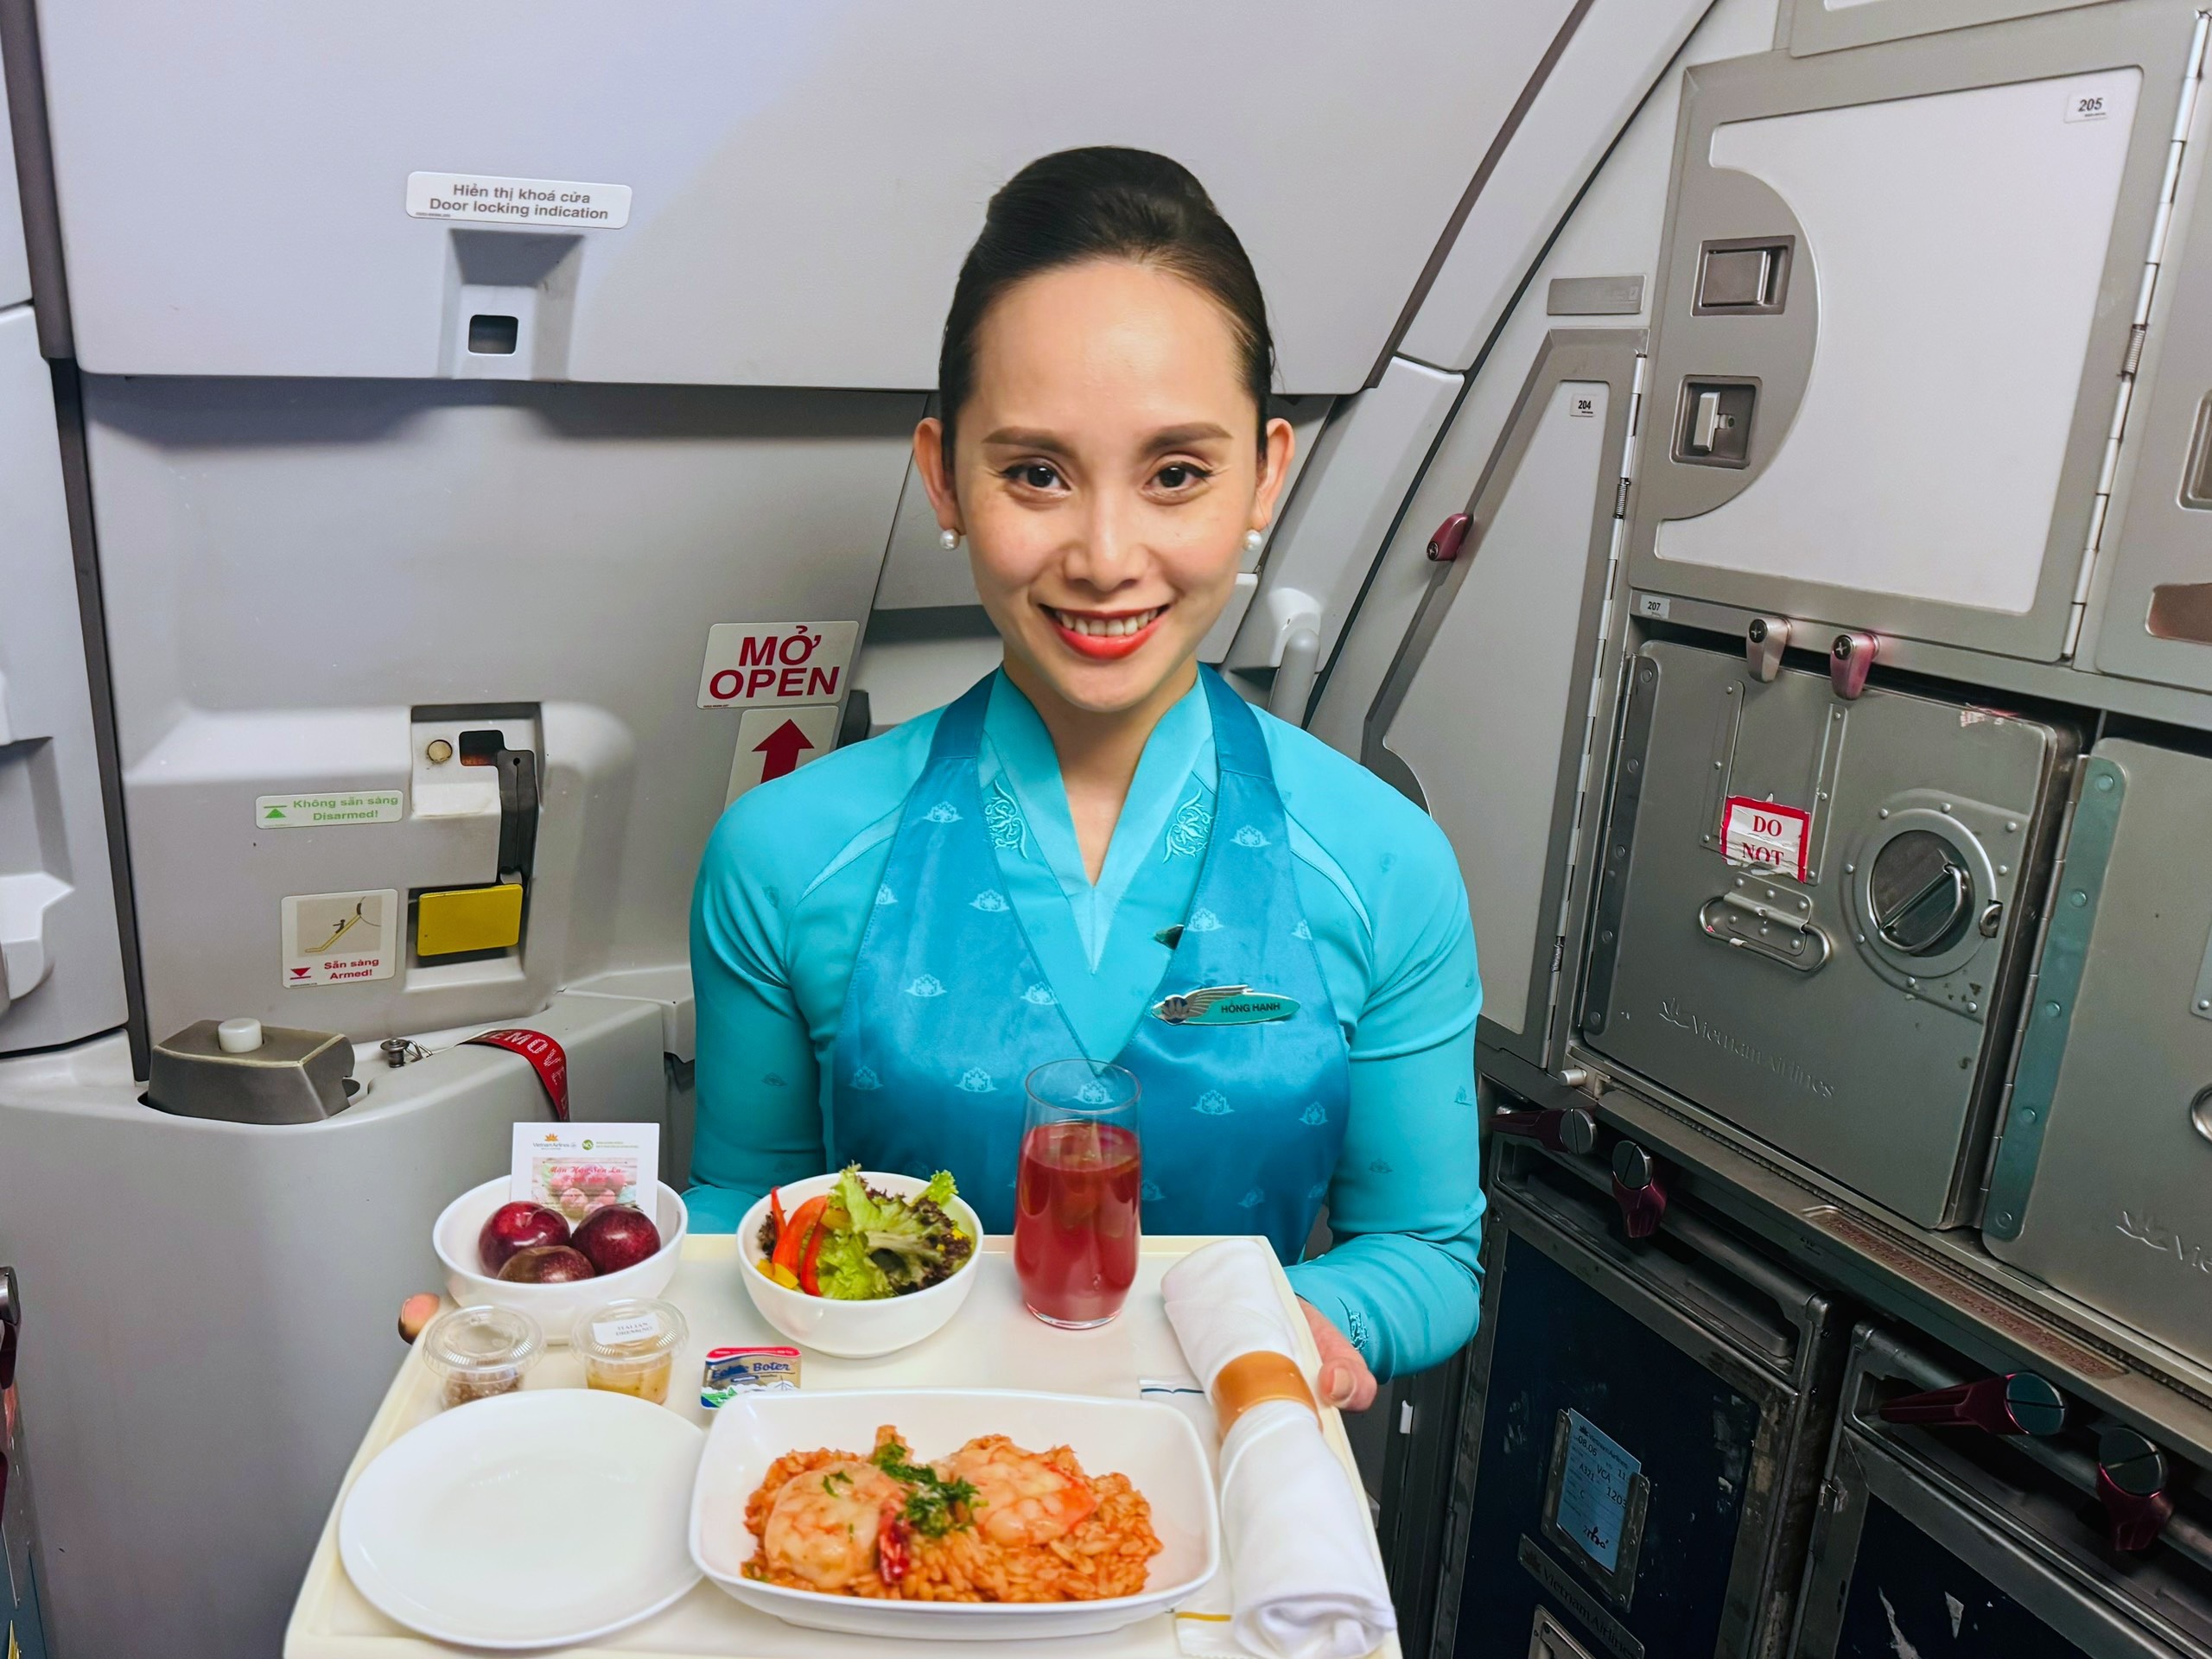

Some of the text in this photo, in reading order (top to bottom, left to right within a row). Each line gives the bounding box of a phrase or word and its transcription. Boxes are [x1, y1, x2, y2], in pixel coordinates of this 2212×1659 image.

[2078, 97, 2103, 112] 205
[453, 182, 591, 204] Hiển thị khoá cửa
[429, 198, 608, 220] Door locking indication
[1578, 400, 1591, 410] 204
[1647, 601, 1661, 611] 207
[738, 626, 822, 667] MỞ
[709, 666, 841, 700] OPEN
[293, 798, 336, 809] Không
[313, 810, 378, 821] Disarmed!
[1753, 815, 1783, 837] DO
[1742, 842, 1784, 866] NOT
[329, 969, 372, 980] Armed!
[753, 1362, 791, 1372] Boter
[1579, 1463, 1595, 1482] A321
[1596, 1464, 1611, 1483] VCA
